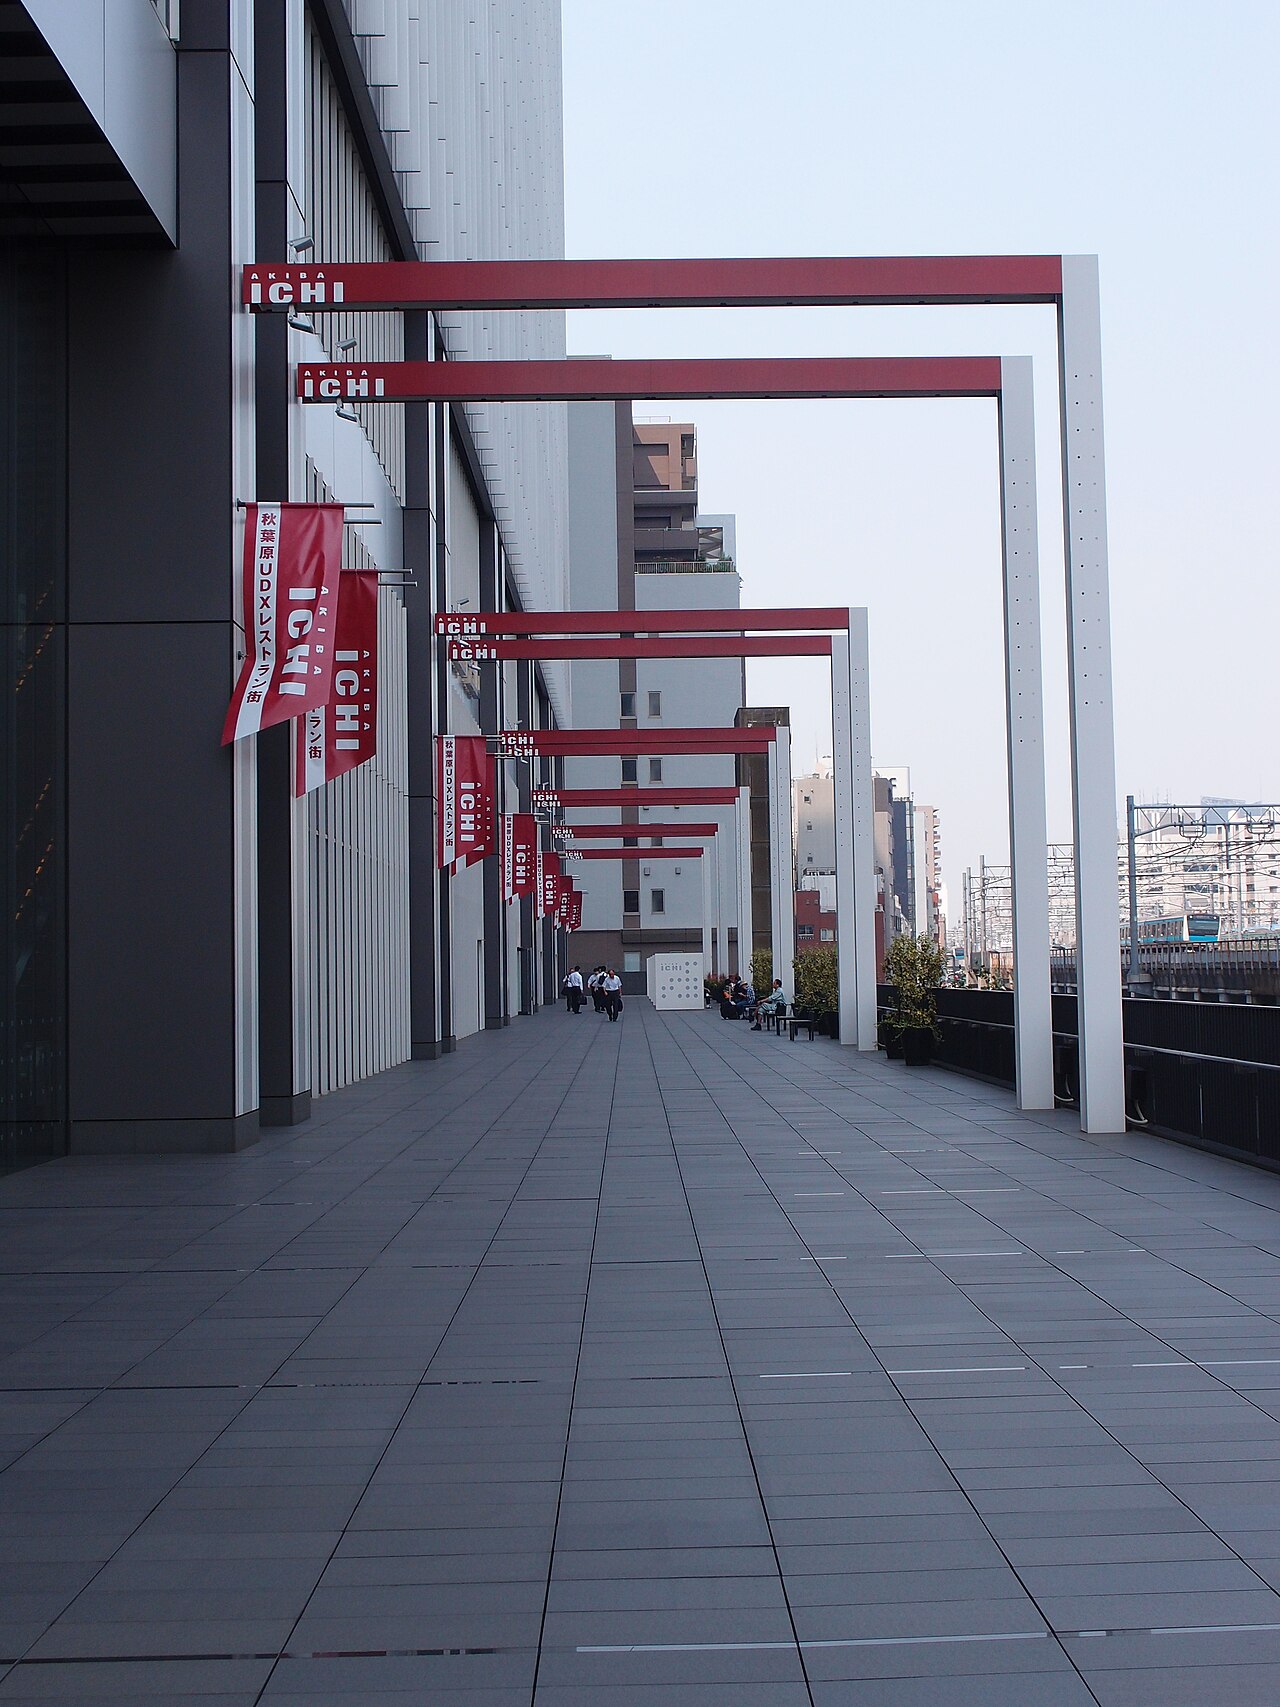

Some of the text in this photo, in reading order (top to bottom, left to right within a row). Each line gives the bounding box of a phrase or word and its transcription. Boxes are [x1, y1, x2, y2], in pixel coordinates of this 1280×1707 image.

[251, 272, 325, 280] AKIBA
[251, 281, 344, 304] ICHI
[304, 378, 385, 397] ICHI
[246, 512, 277, 704] 秋葉原UDXレストラン街
[278, 587, 317, 696] ICHI
[313, 585, 330, 676] AKIBA
[438, 622, 486, 634] ICHI
[452, 648, 497, 660] ICHI
[335, 650, 360, 750] ICHI
[501, 736, 534, 745] ICHI
[460, 782, 475, 842] ICHI
[516, 844, 527, 884] ICHI
[545, 874, 554, 905] ICHI
